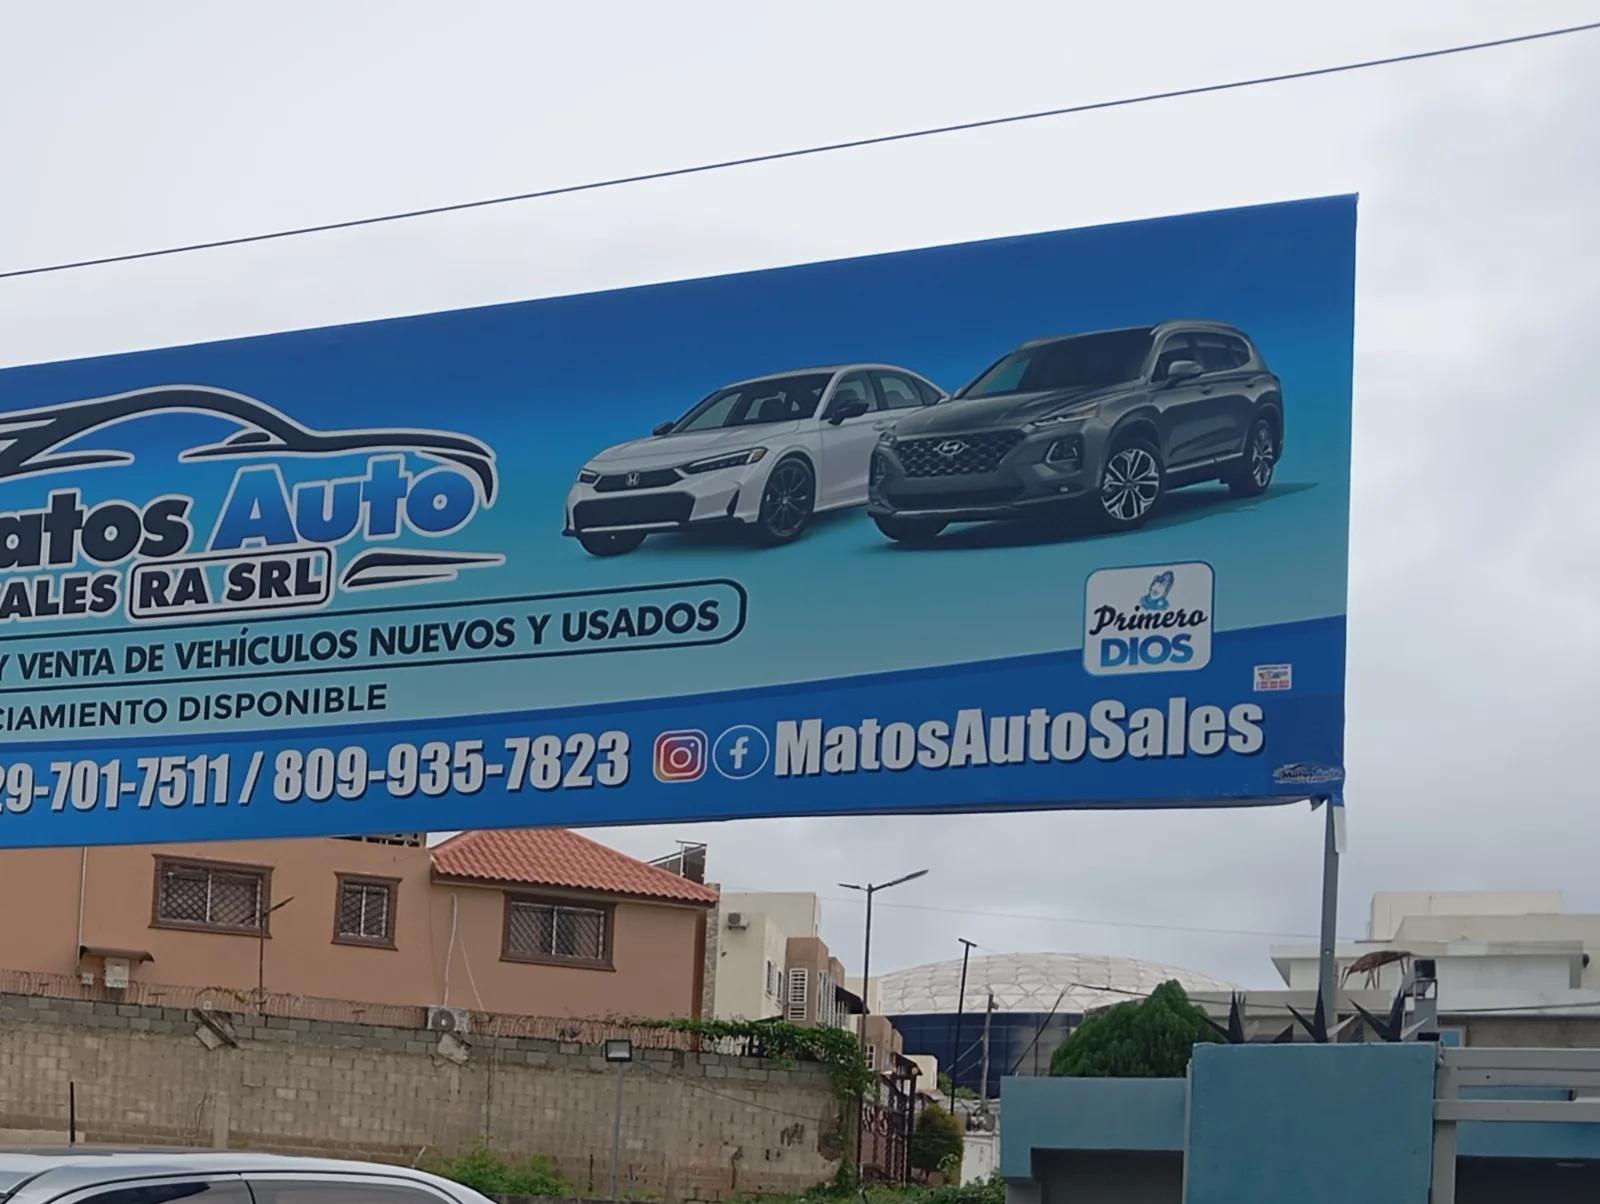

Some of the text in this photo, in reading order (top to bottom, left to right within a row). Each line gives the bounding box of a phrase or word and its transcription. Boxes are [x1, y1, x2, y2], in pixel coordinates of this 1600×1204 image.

[209, 457, 477, 552] Auto
[137, 565, 213, 608] RA
[226, 557, 323, 602] SRL
[17, 646, 115, 680] VENTA
[124, 642, 165, 674] DE
[175, 627, 358, 670] VEHÍCULOS
[369, 616, 515, 658] NUEVOS
[527, 615, 552, 645] Y
[561, 600, 720, 643] USADOS
[1088, 604, 1208, 636] Primero
[1099, 633, 1195, 668] DIOS
[178, 684, 388, 722] DISPONIBLE
[272, 730, 631, 803] 809-935-7823
[774, 697, 1266, 777] MatosAutoSales
